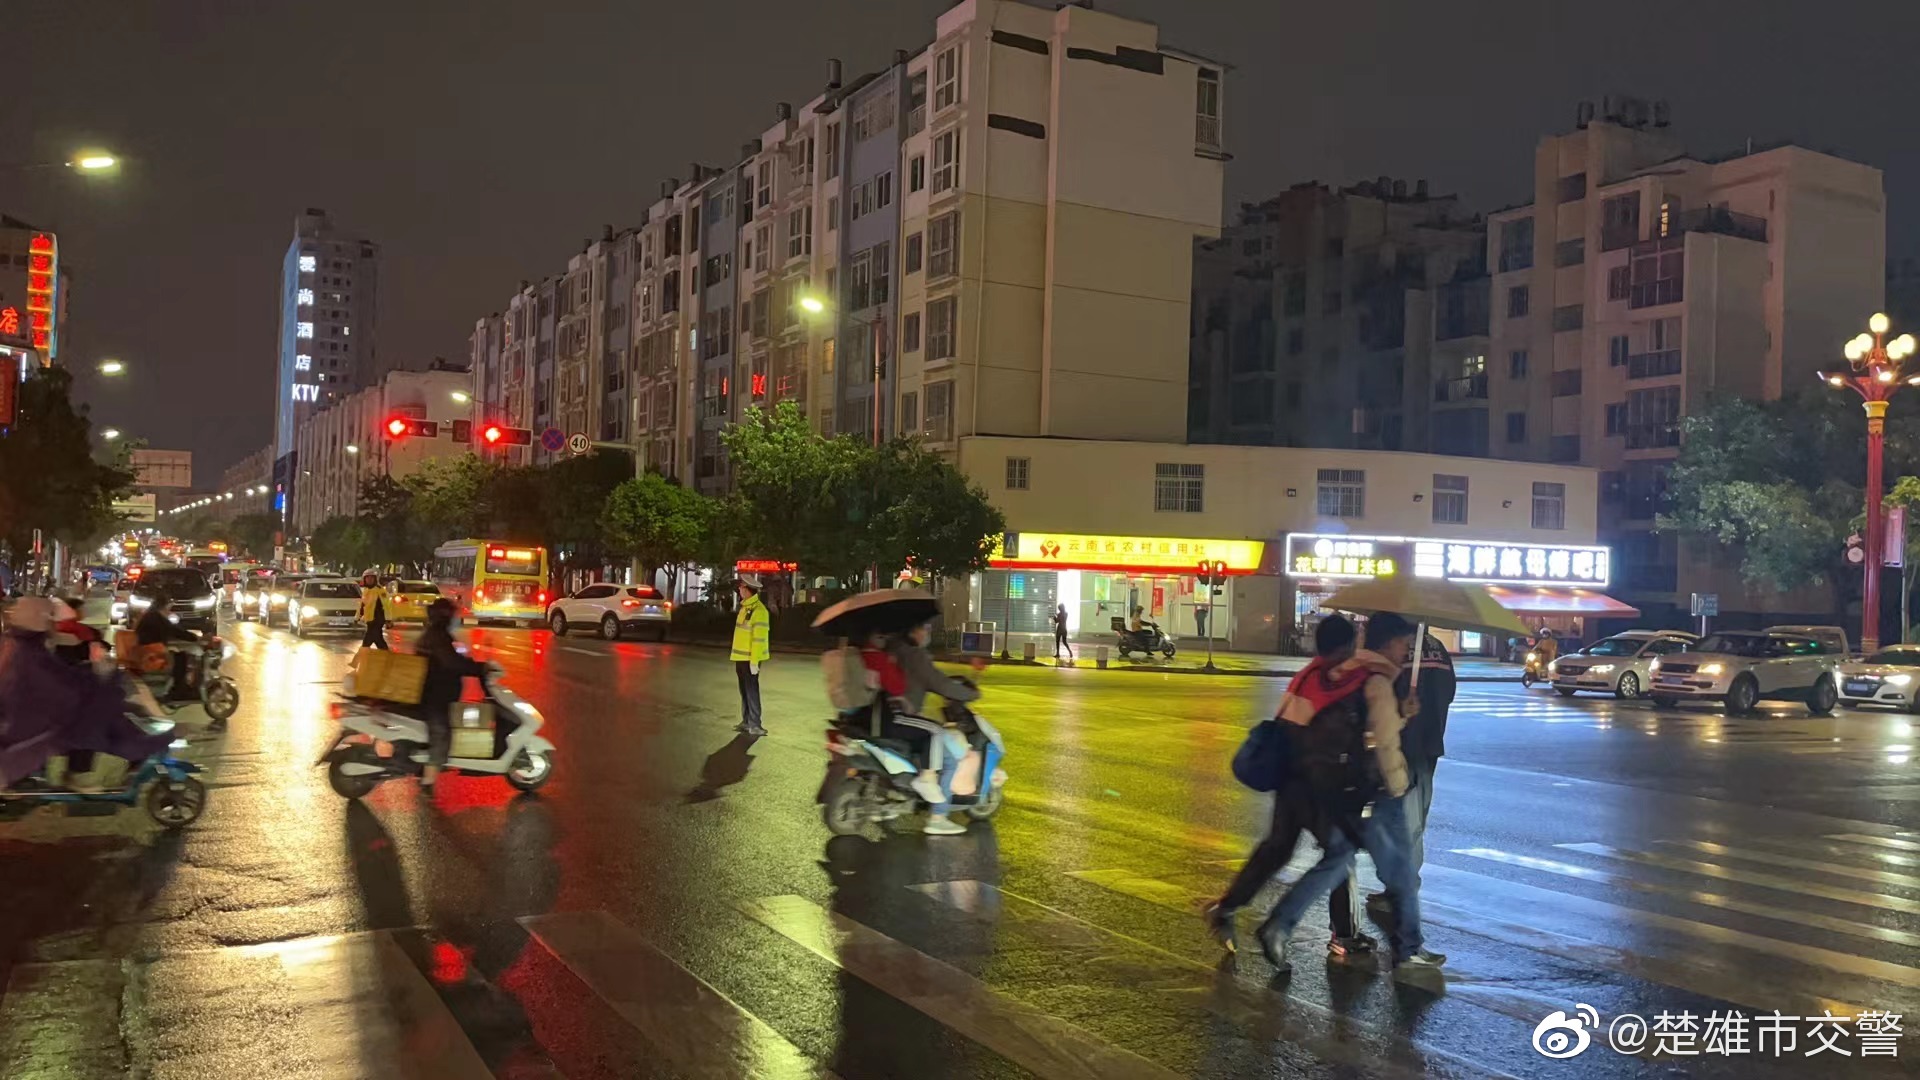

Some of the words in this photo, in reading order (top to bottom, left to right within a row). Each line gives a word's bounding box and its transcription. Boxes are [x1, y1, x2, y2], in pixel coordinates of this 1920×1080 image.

[295, 255, 317, 371] 爱尚酒店
[291, 383, 320, 402] KTV
[571, 437, 587, 449] 40
[1069, 539, 1205, 555] 云南省农村信用社
[1408, 650, 1443, 661] PLICE
